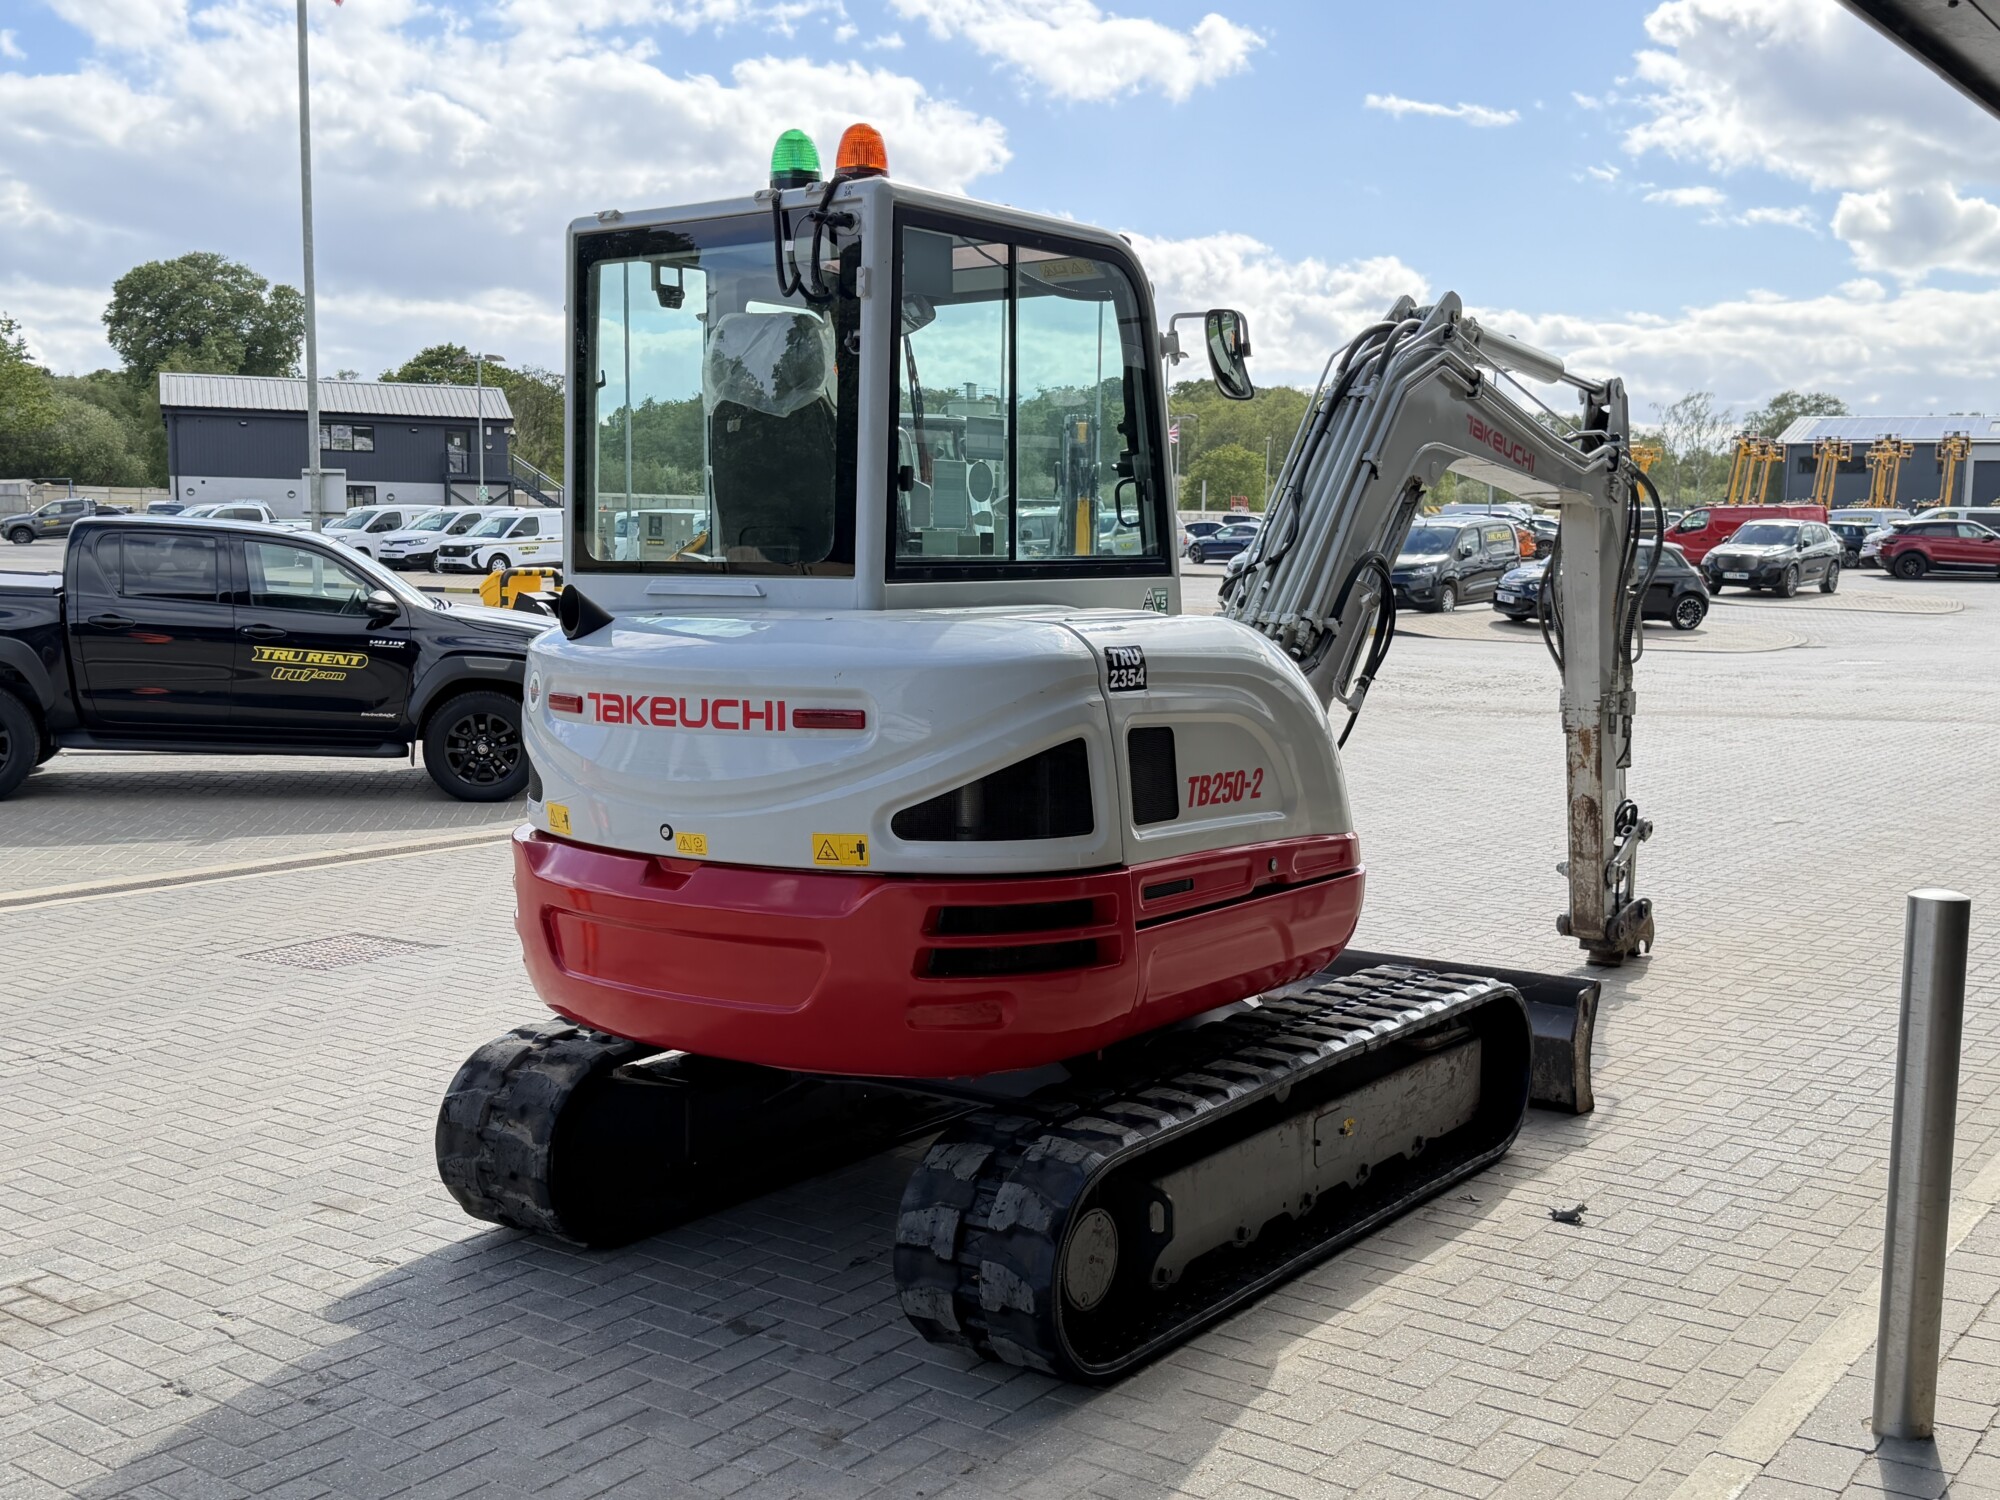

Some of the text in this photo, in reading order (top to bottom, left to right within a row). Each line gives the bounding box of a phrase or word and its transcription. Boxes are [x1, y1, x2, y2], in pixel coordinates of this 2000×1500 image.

[261, 648, 363, 666] TRU RENT
[1108, 647, 1141, 667] TRU
[271, 667, 346, 682] tru7.com
[1110, 667, 1145, 689] 2354
[1187, 767, 1264, 808] TB250-2
